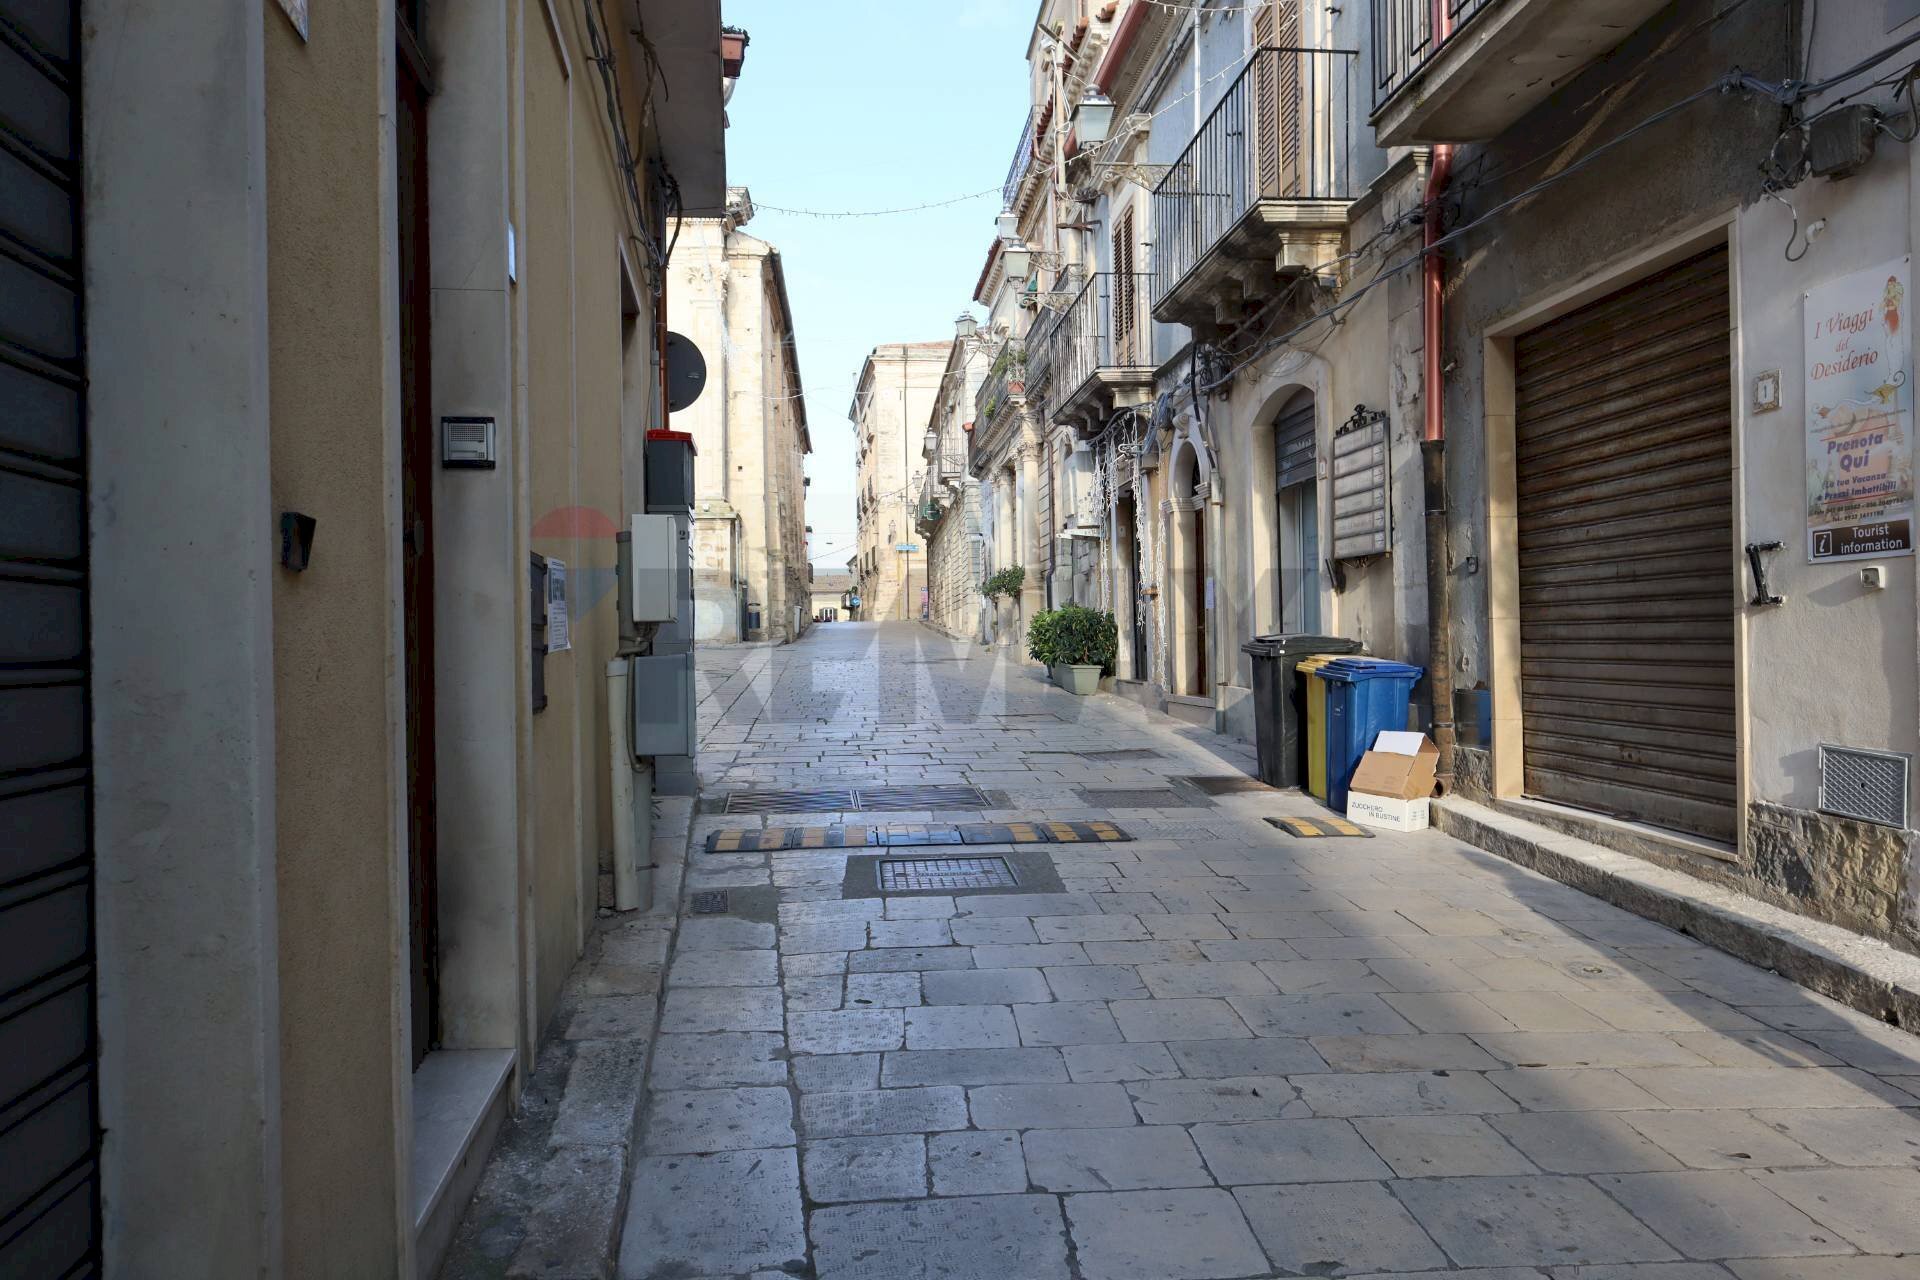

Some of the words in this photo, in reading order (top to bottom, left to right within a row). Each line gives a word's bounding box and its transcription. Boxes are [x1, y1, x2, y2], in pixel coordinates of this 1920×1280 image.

[1814, 320, 1821, 339] I
[1826, 303, 1874, 334] Viaggi
[1836, 337, 1850, 352] del
[1811, 347, 1878, 380] Desiderio
[1827, 433, 1884, 454] Prenota
[1840, 449, 1870, 472] Qui
[1852, 523, 1889, 538] Tourist
[1840, 538, 1903, 554] information
